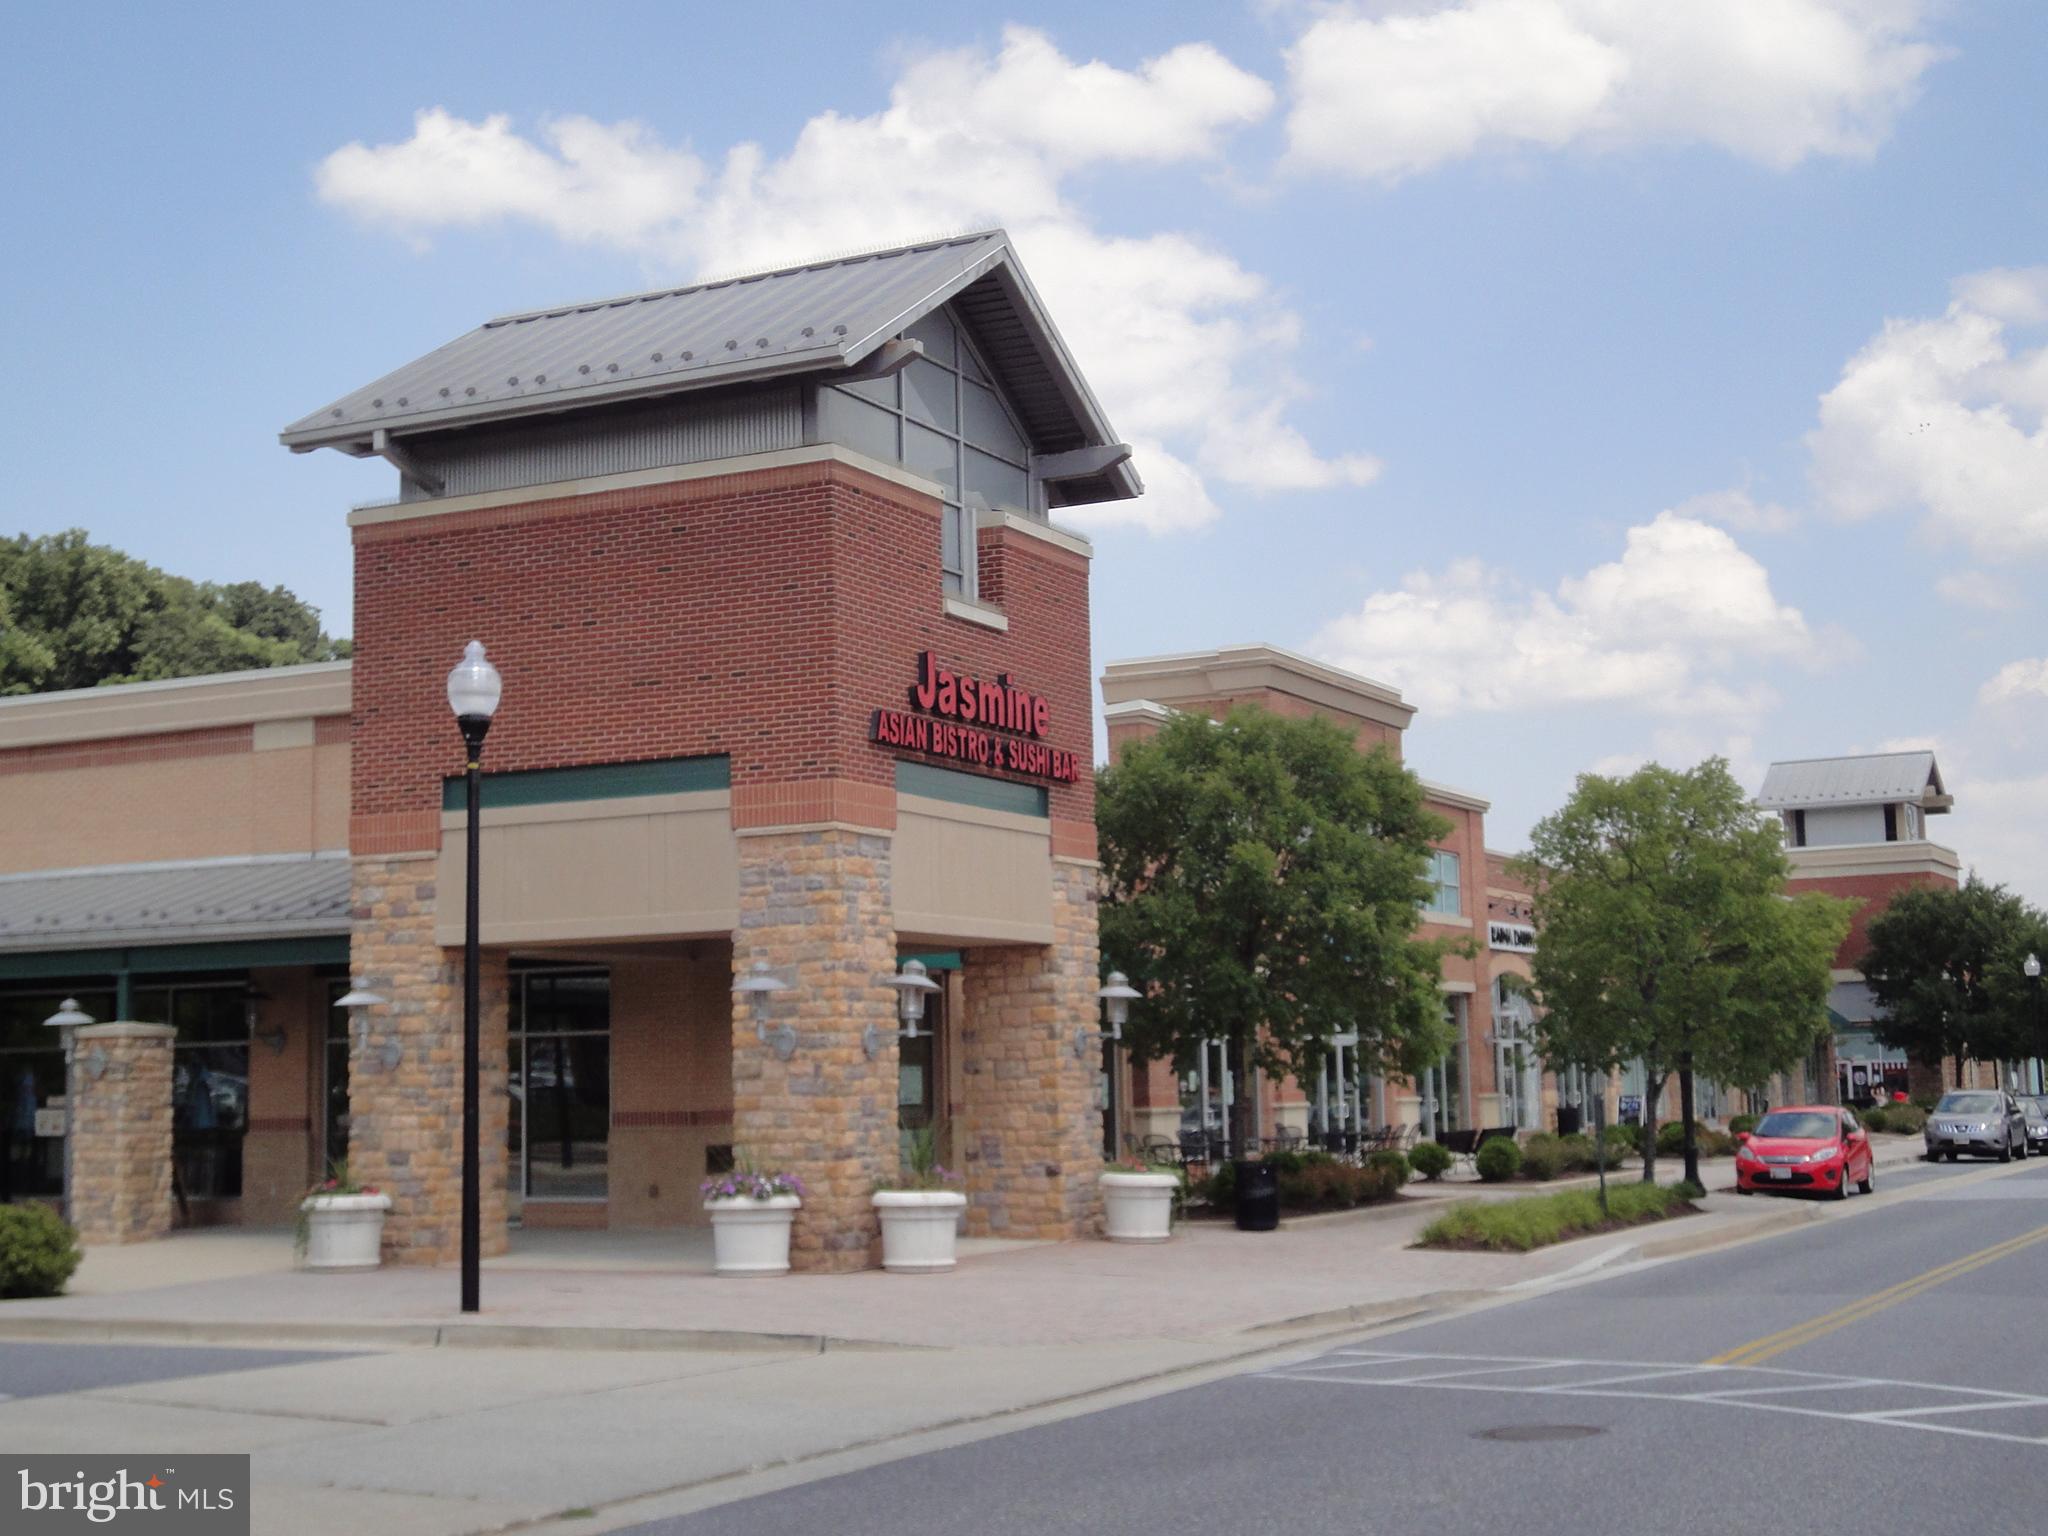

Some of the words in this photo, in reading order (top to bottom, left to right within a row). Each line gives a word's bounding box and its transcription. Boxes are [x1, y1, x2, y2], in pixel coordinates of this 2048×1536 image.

[912, 650, 1051, 736] Jasmine
[877, 710, 928, 750] ASIAN
[932, 722, 989, 763] BISTRO
[993, 738, 1003, 766] &
[1008, 739, 1050, 776] SUSHI
[1052, 751, 1080, 782] BAR
